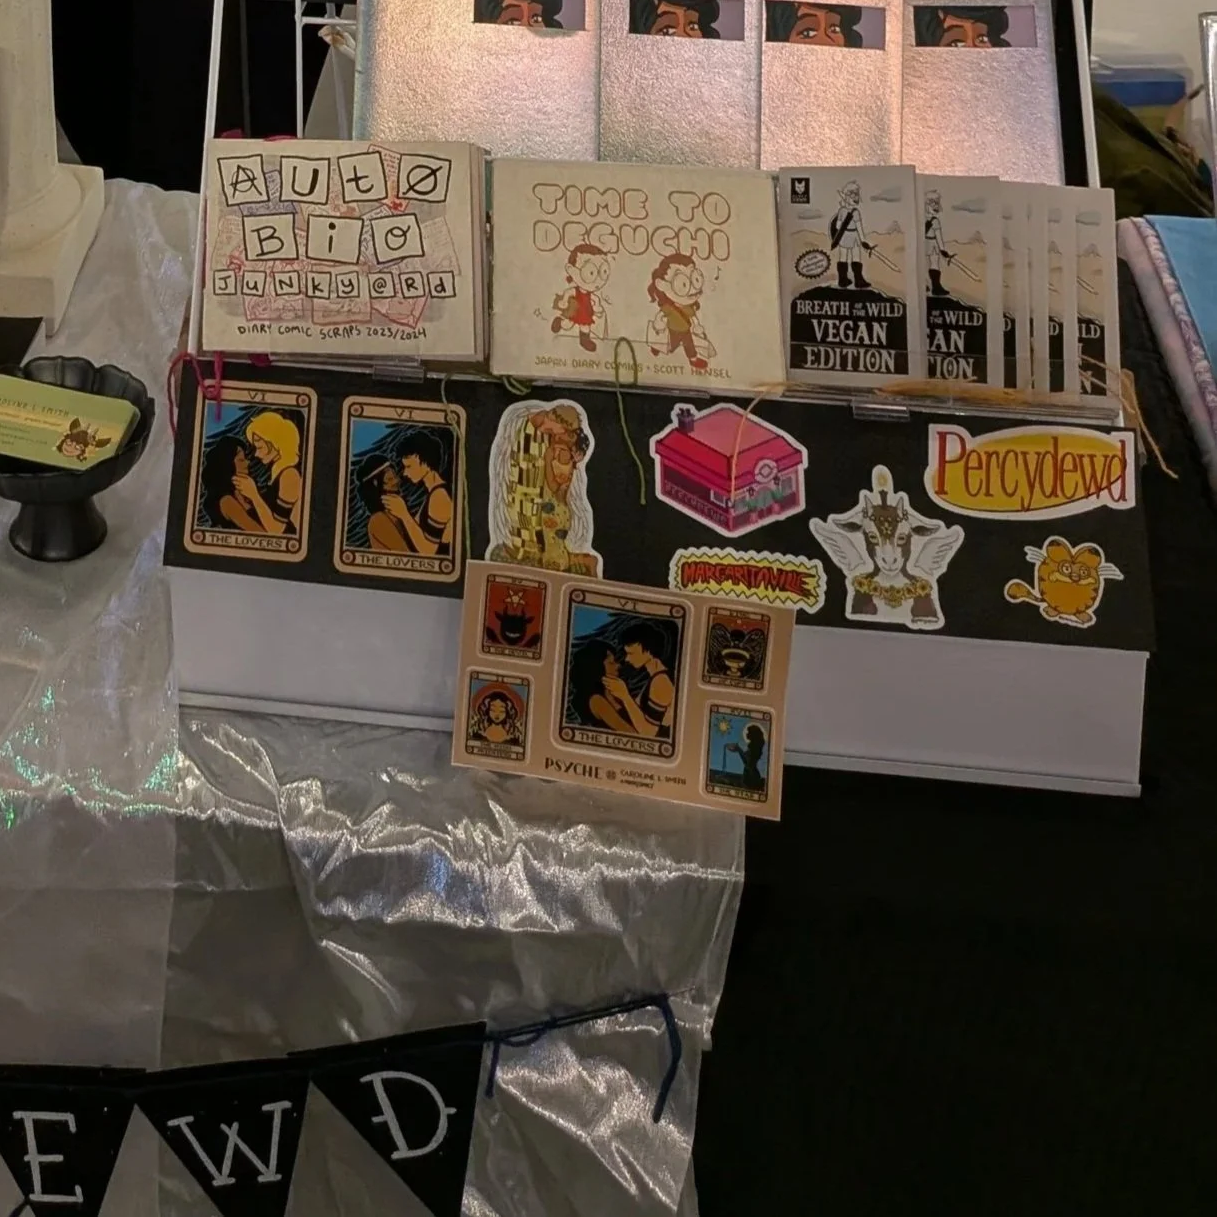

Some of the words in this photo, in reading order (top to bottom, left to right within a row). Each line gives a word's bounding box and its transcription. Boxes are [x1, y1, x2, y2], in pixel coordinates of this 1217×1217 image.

[533, 183, 649, 220] TIME
[669, 190, 731, 225] TO
[533, 220, 731, 261] DEGUCHI
[796, 299, 850, 316] BREATH
[866, 301, 903, 318] WILD
[945, 310, 983, 326] WILD
[319, 326, 362, 340] SCRAPS
[366, 326, 427, 341] 2023/2024
[811, 319, 888, 346] VEGAN
[534, 356, 567, 367] JAPAN
[572, 357, 601, 370] DIARY
[604, 360, 644, 373] COMICS
[653, 364, 684, 376] SCOTT
[802, 345, 896, 374] EDITION
[248, 391, 267, 401] VI
[395, 408, 414, 420] VI
[936, 431, 1127, 512] Percydewd
[209, 534, 233, 545] THE
[235, 535, 283, 549] LOVERS
[359, 554, 383, 565] THE
[386, 556, 437, 570] LOVERS
[619, 598, 638, 611] VI
[578, 732, 603, 744] THE
[605, 734, 656, 753] LOVERS
[544, 757, 603, 780] PSYCHE
[619, 769, 655, 781] CAROLINE
